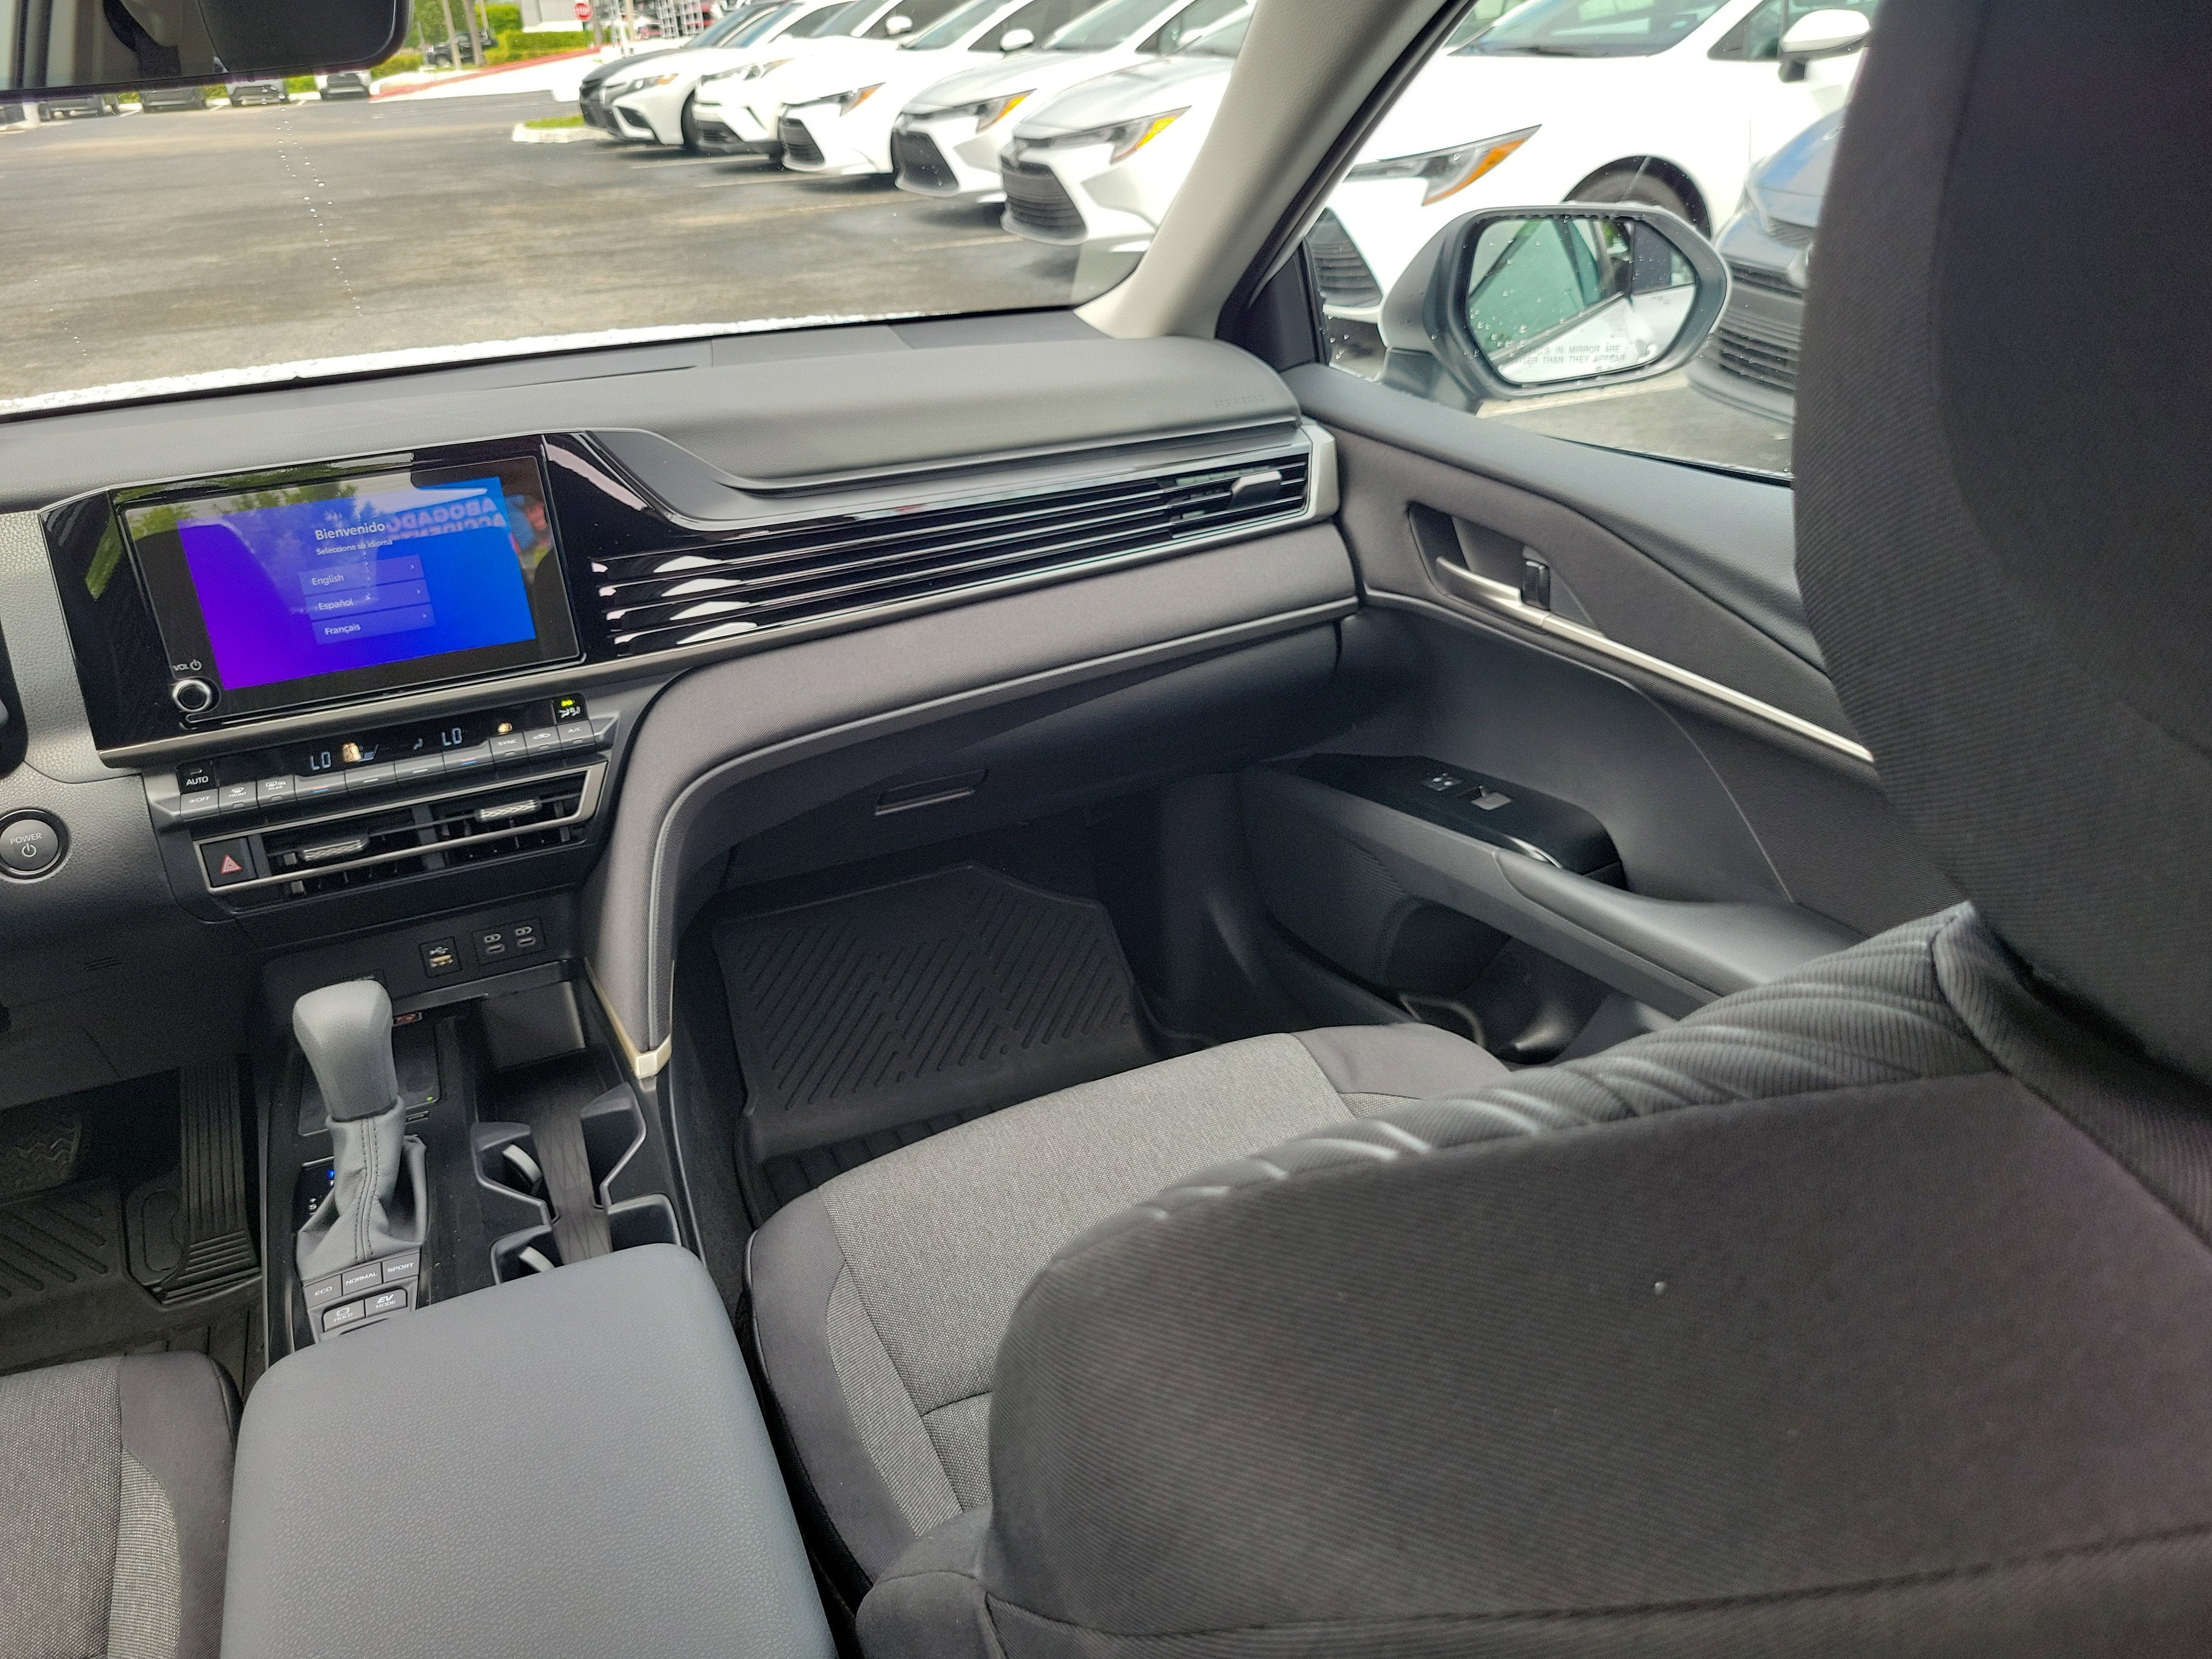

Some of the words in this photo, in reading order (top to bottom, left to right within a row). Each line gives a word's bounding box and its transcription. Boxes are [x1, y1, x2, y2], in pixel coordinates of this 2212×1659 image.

[1555, 346, 1563, 354] IN
[1568, 345, 1600, 354] MIRROR
[1604, 345, 1621, 354] ARE
[1543, 356, 1564, 364] THAN
[1568, 355, 1589, 364] THEY
[1593, 354, 1626, 363] APPEAR
[314, 521, 386, 541] Bienvenido
[316, 545, 357, 555] Seleccione
[368, 539, 393, 549] idioma
[311, 573, 345, 586] English
[318, 597, 354, 611] Español
[324, 623, 361, 636] Français
[172, 663, 190, 671] VOL
[442, 727, 462, 746] LO
[498, 738, 517, 747] SYNC
[310, 751, 331, 771] LO
[185, 775, 209, 787] AUTO
[10, 833, 43, 845] POWER
[387, 1262, 415, 1273] SPORT
[346, 1272, 378, 1285] NORMAL
[314, 1286, 333, 1296] ECO
[375, 1300, 397, 1310] MODE
[377, 1294, 394, 1304] EV
[334, 1312, 354, 1323] HOLD
